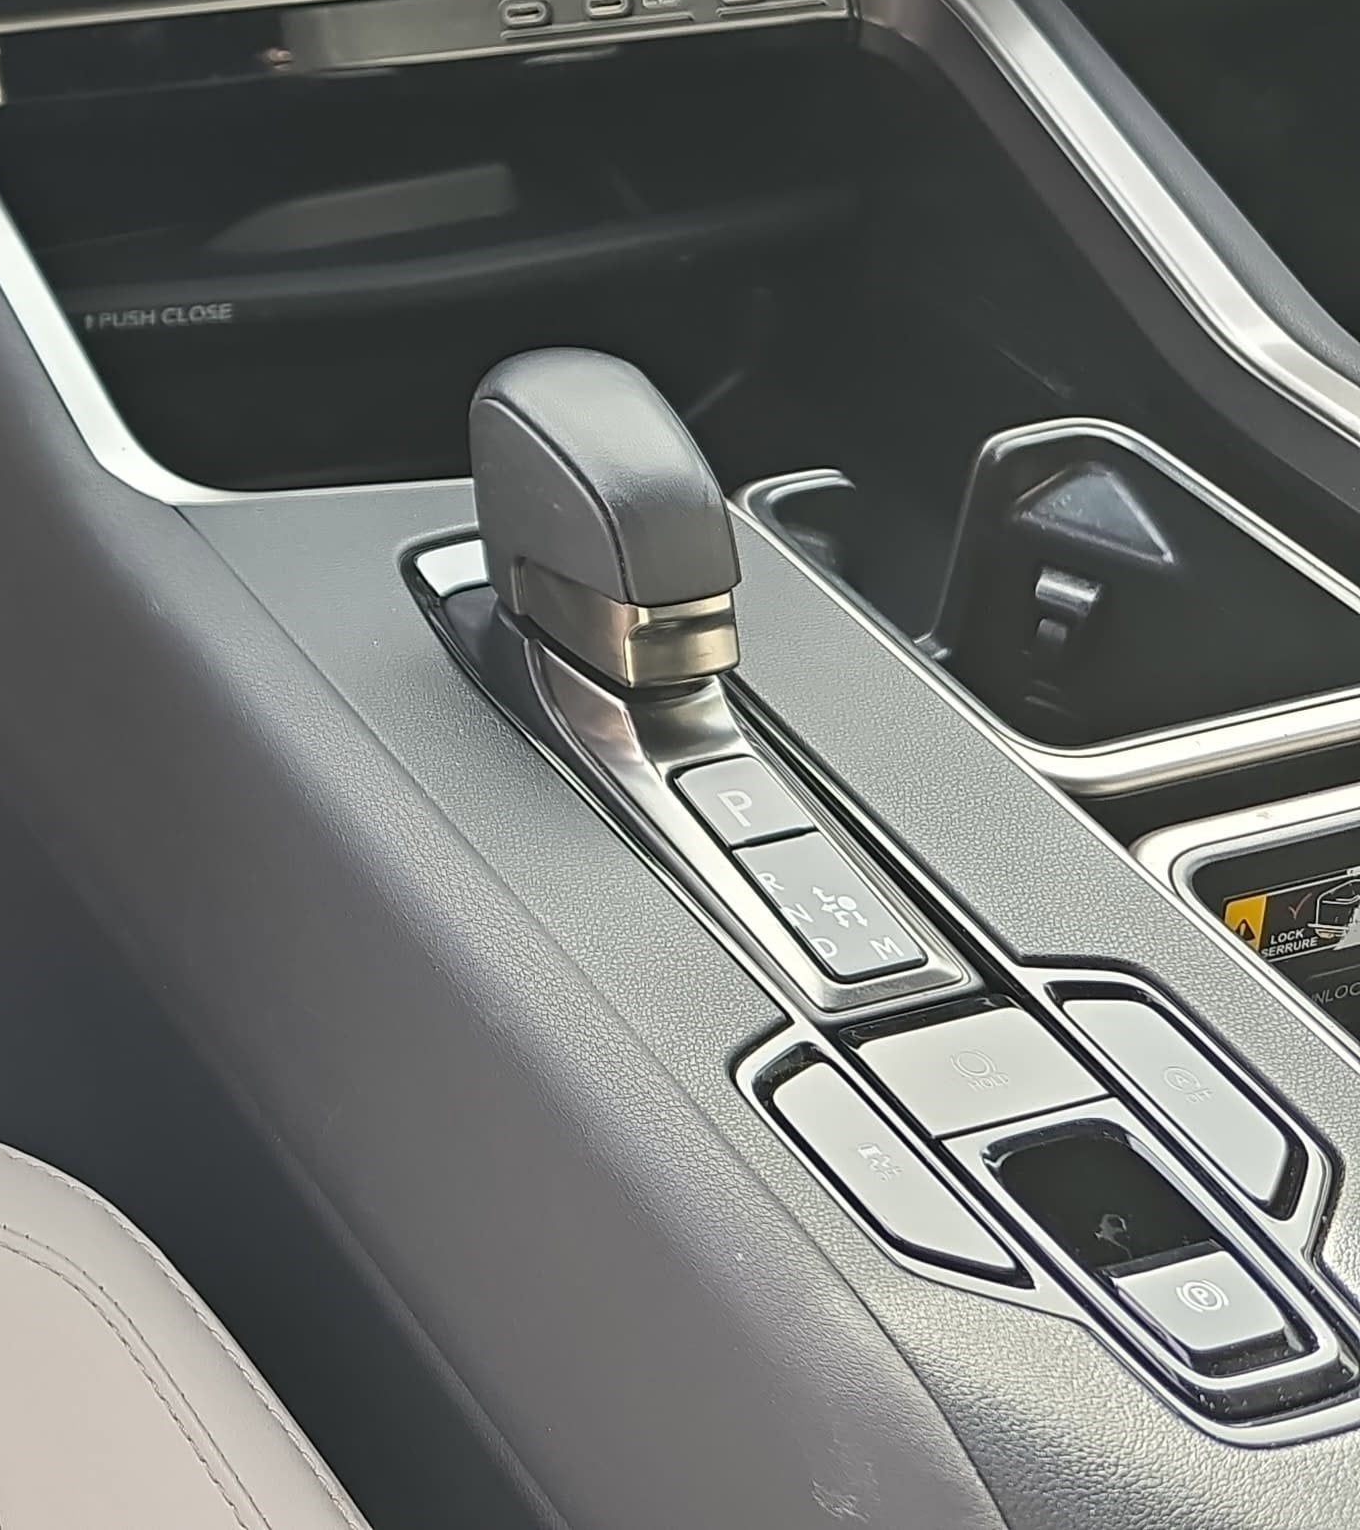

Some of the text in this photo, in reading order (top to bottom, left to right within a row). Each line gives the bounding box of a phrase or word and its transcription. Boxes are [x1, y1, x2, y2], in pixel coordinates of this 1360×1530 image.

[99, 302, 234, 329] PUSH CLOSE
[717, 790, 753, 828] P
[757, 871, 785, 894] R
[781, 903, 814, 928] N
[810, 937, 838, 959] D
[869, 936, 904, 961] M
[1260, 936, 1319, 959] SERRURE
[1269, 928, 1306, 946] LOCK
[967, 1071, 1010, 1091] HOLD
